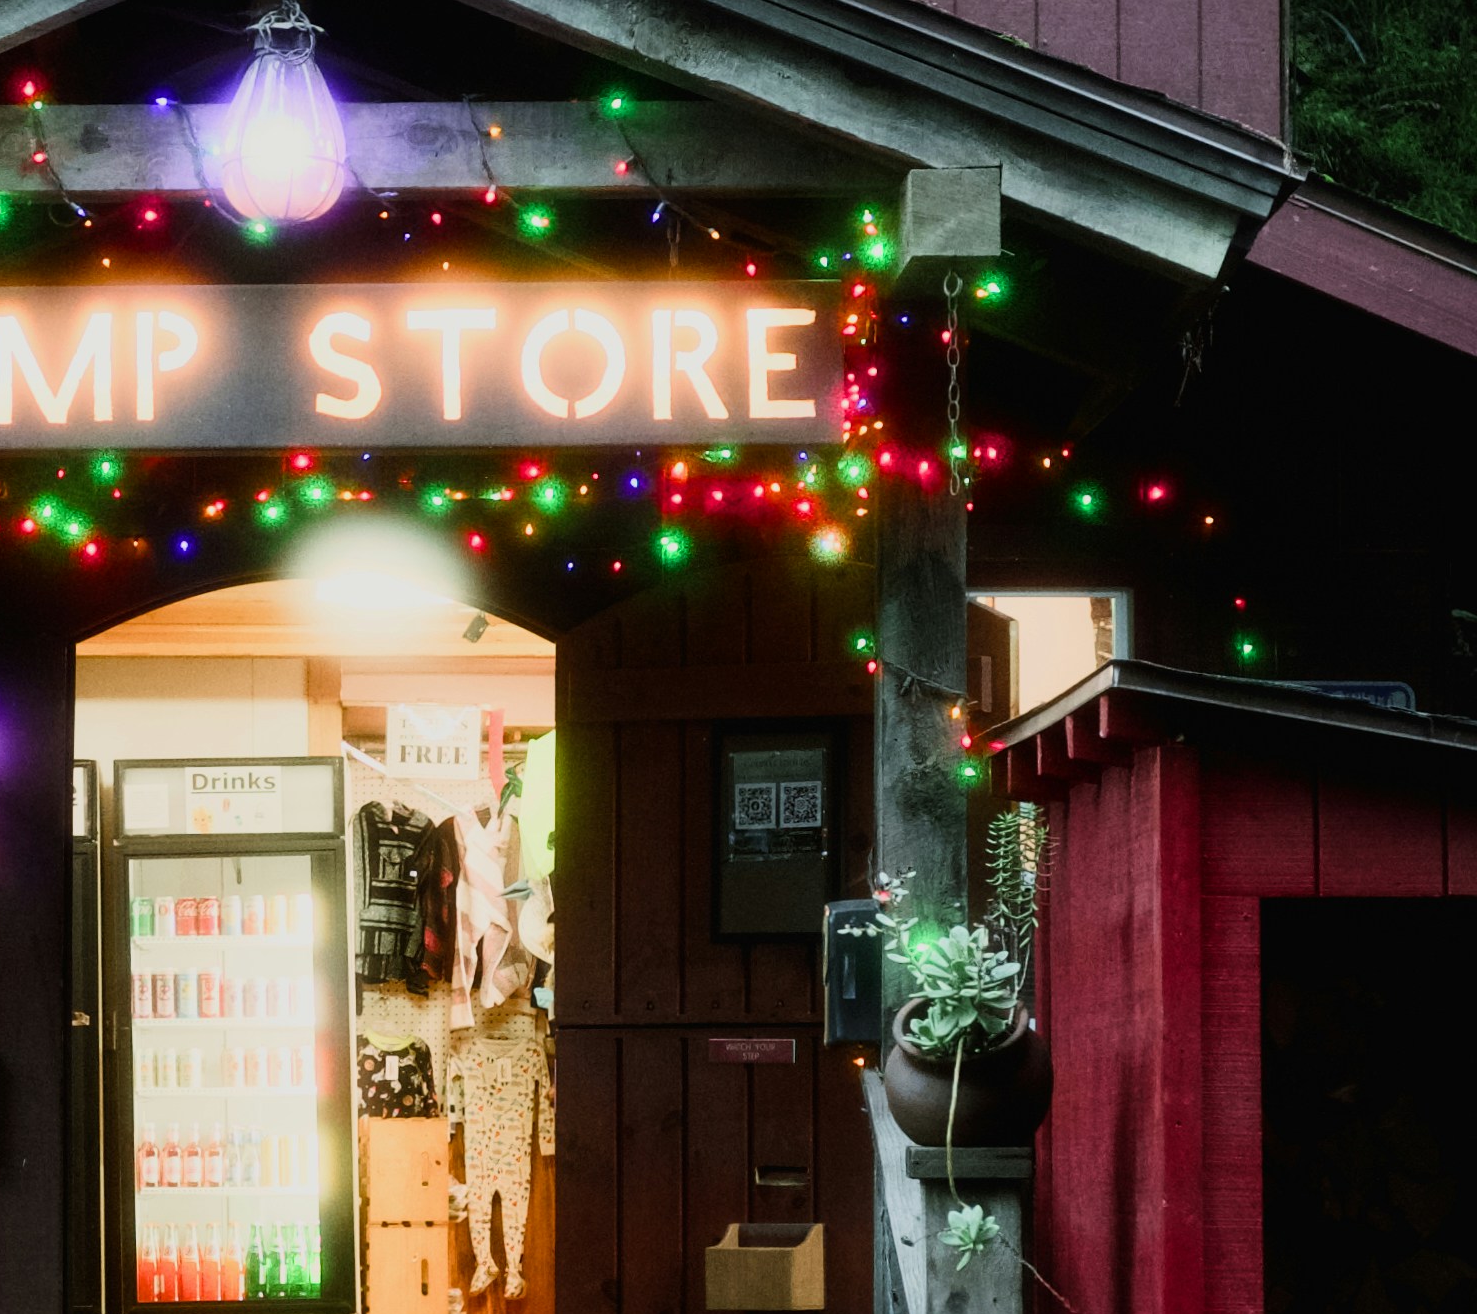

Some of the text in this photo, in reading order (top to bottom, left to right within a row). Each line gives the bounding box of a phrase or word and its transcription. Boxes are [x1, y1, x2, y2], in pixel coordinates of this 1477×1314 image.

[309, 305, 819, 423] STORE
[399, 745, 469, 765] FREE
[191, 772, 276, 791] Drinks
